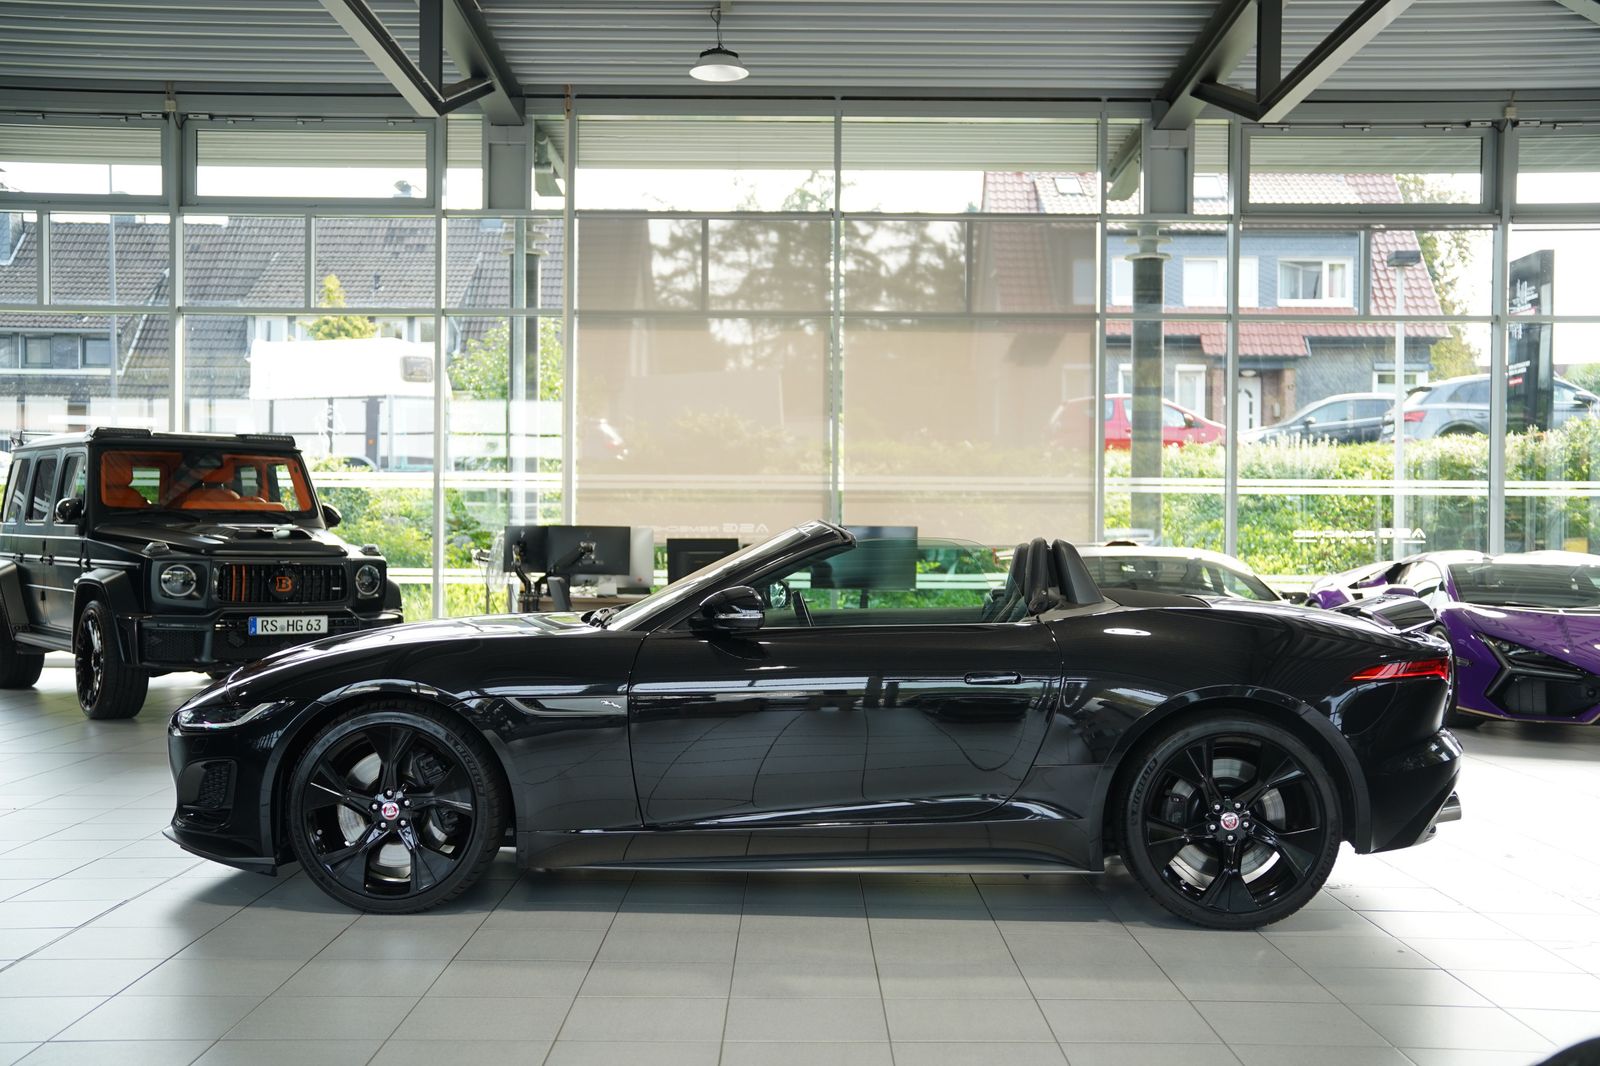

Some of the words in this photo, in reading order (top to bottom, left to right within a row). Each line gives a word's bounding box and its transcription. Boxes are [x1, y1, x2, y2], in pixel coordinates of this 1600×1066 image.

[275, 576, 294, 592] B
[261, 619, 278, 632] RS
[286, 619, 303, 632] HG
[306, 619, 321, 632] 63
[454, 743, 486, 795] MICHELIN
[1131, 759, 1157, 814] MICHELIN
